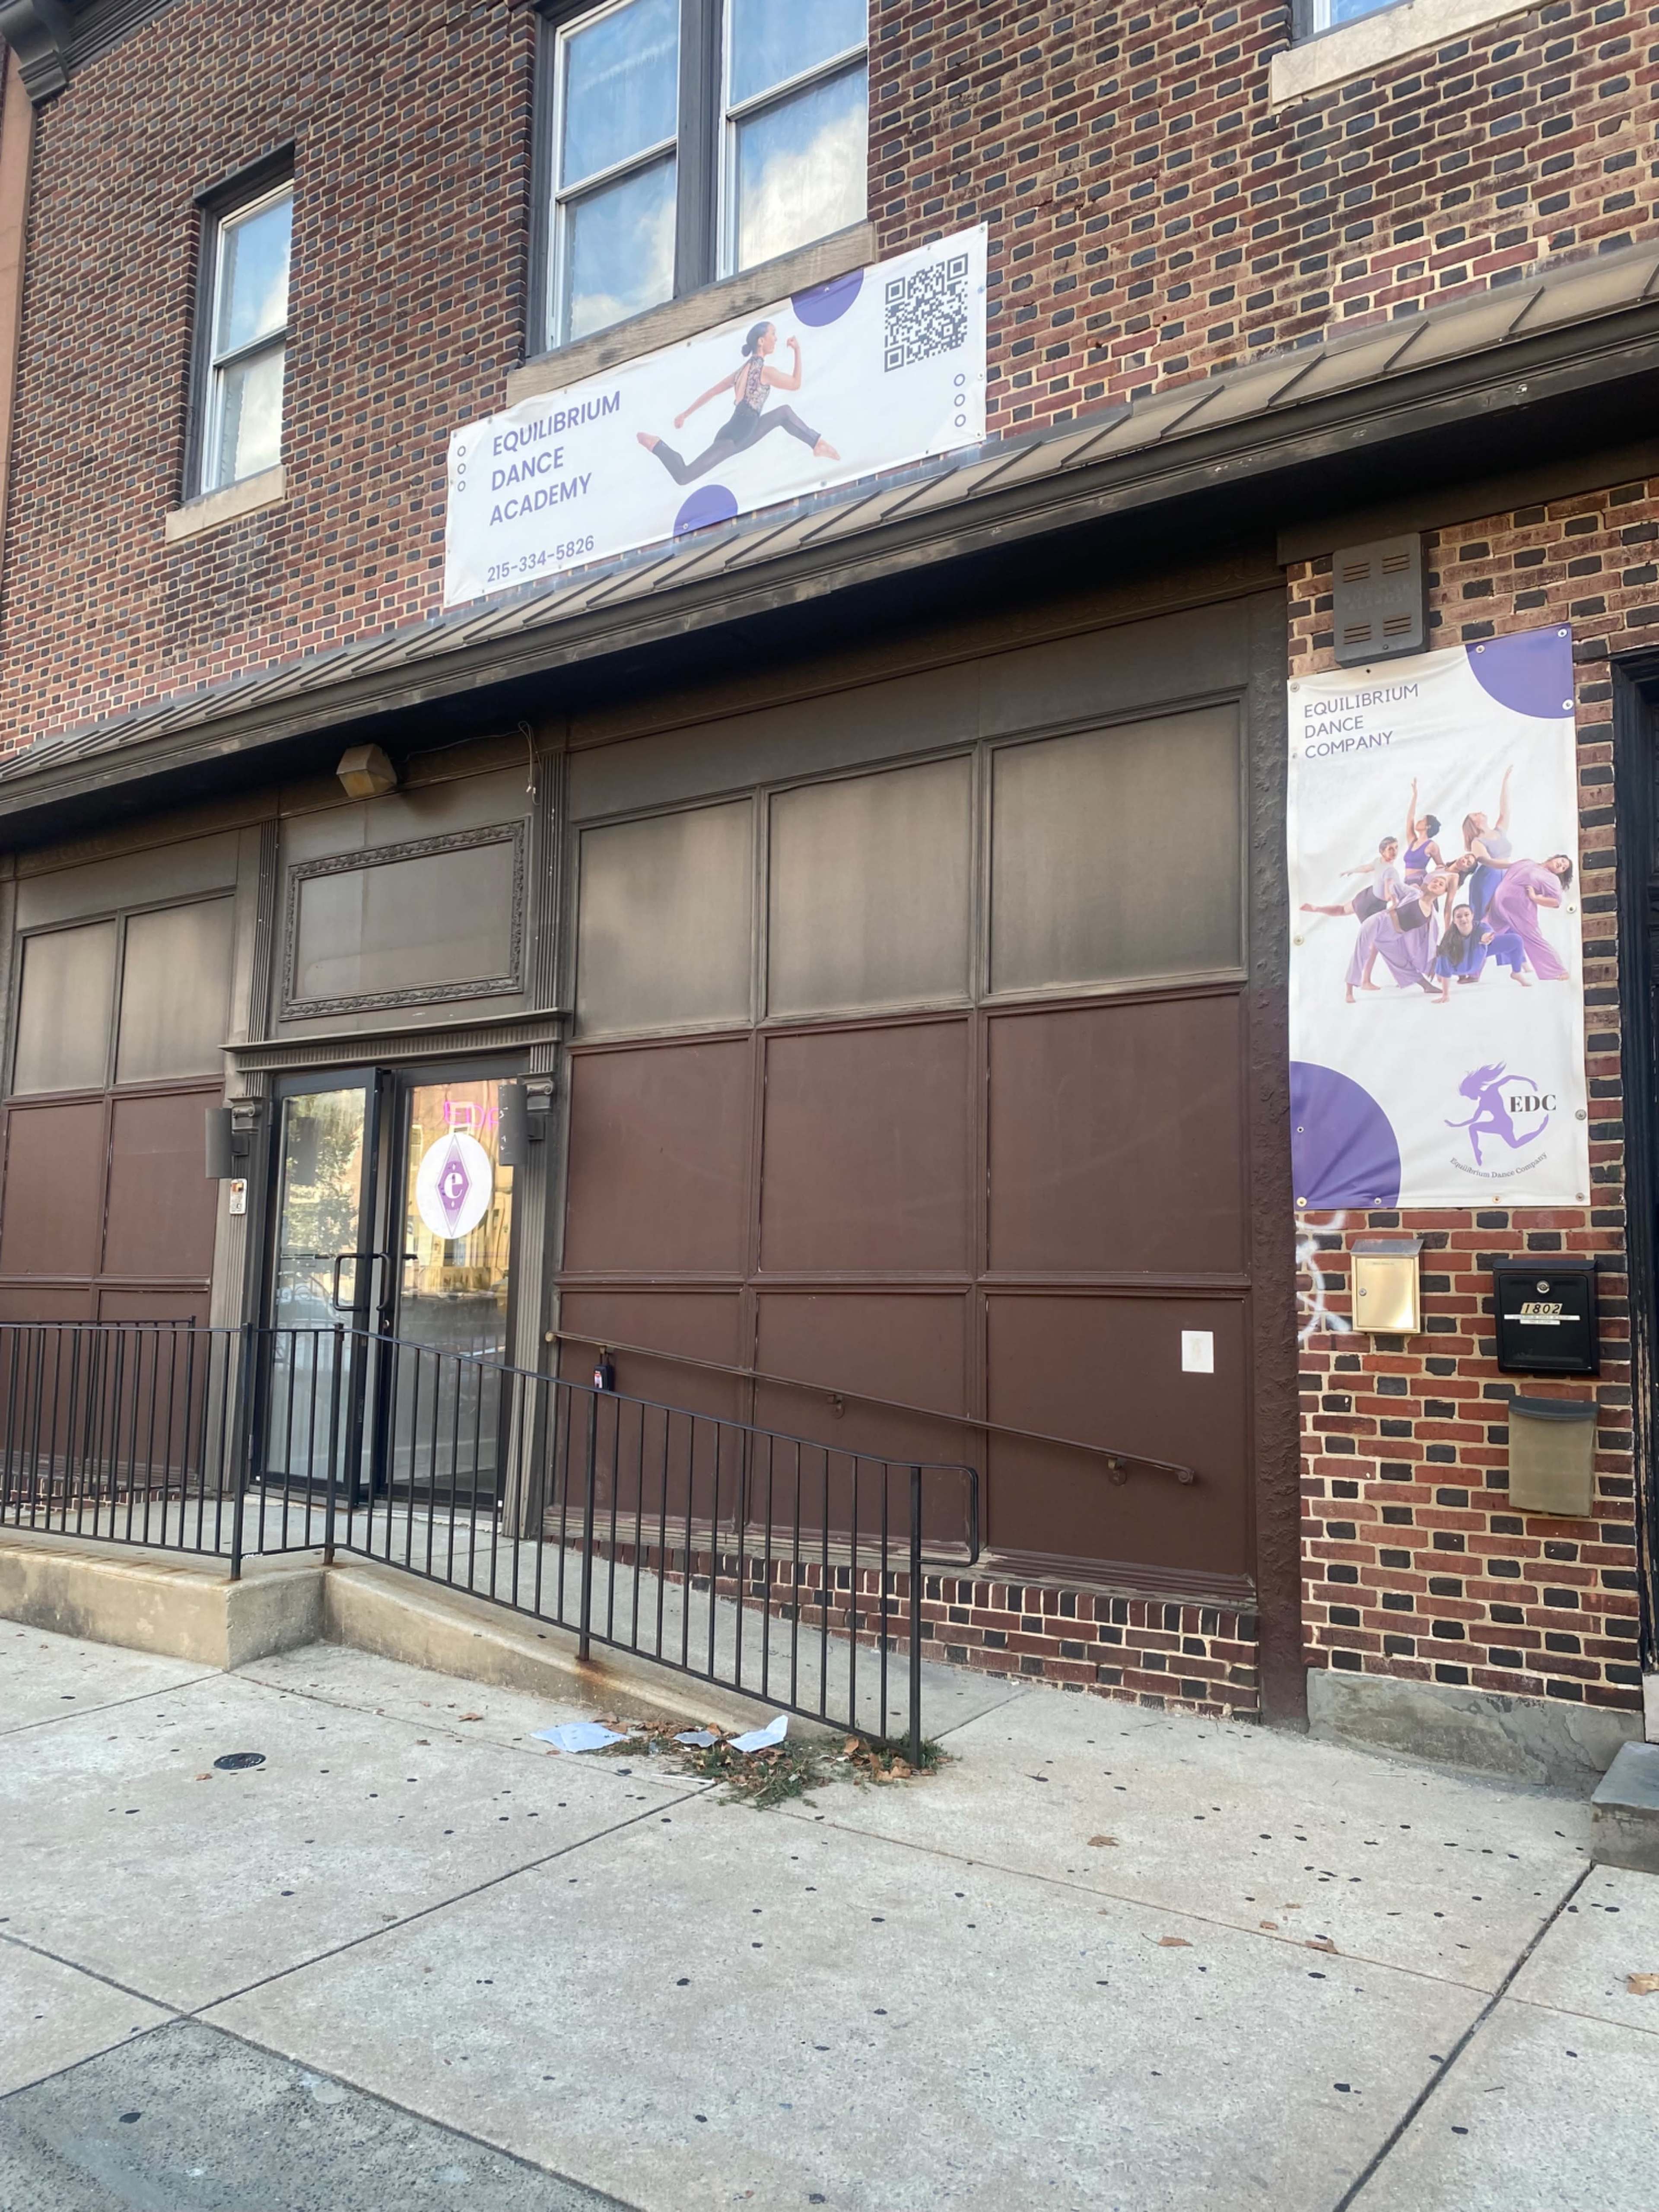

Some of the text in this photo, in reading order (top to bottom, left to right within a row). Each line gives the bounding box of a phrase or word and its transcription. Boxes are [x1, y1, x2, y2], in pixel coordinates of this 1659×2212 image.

[493, 391, 620, 456] EQUILIBRIUM
[491, 447, 563, 491] DANCE
[489, 473, 592, 526] ACADEMY
[487, 535, 594, 582] 215-334-5826
[1304, 683, 1418, 718] EQUILIBRIUM
[1305, 715, 1363, 738] DANCE
[1305, 731, 1393, 759] COMPANY
[1510, 1094, 1557, 1112] EDC
[1450, 1157, 1490, 1178] Equilibrium
[1516, 1152, 1547, 1174] Company
[1525, 1304, 1560, 1314] 1802
